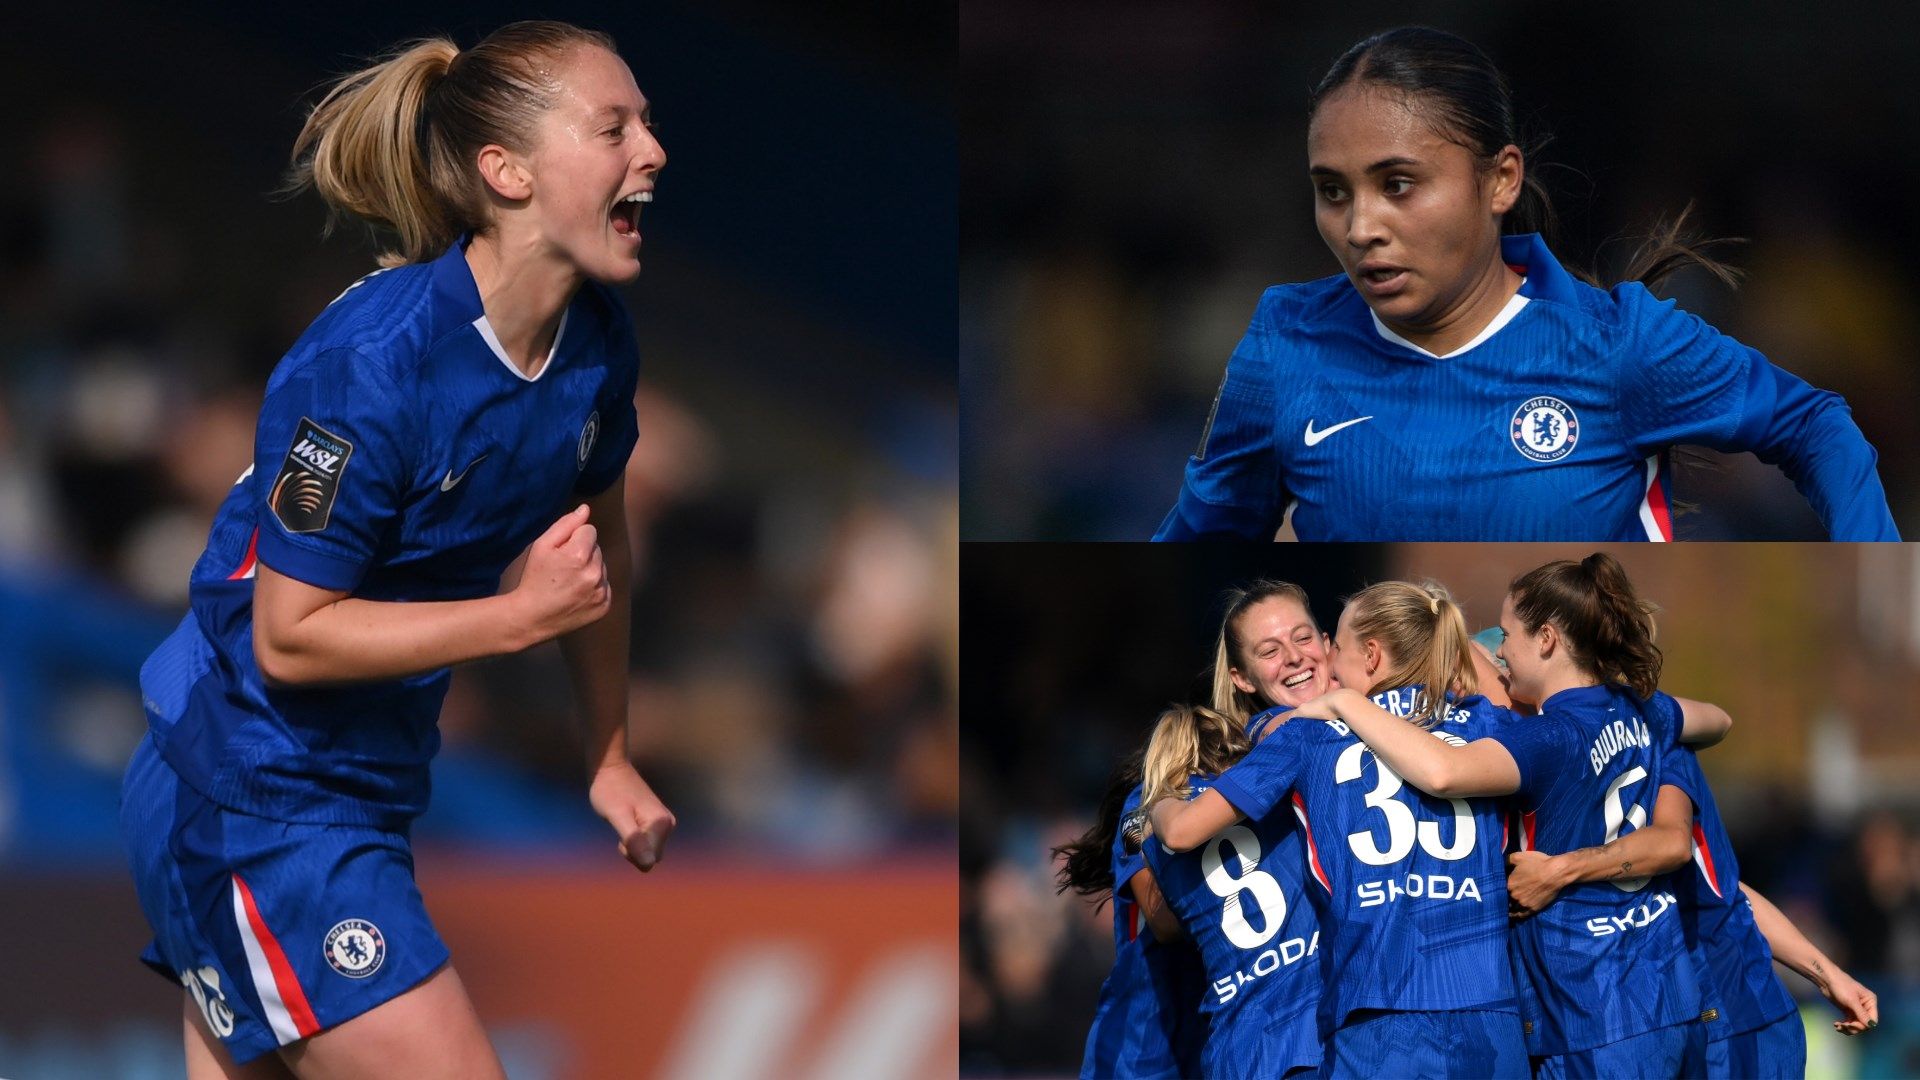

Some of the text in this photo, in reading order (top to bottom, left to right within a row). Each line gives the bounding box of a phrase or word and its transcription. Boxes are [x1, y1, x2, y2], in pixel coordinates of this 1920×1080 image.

[1524, 400, 1567, 415] CHELSEA
[312, 434, 344, 455] BARCLAYS
[1521, 445, 1566, 459] FOOTBALL CLUB
[293, 439, 340, 474] WSL
[1604, 766, 1651, 892] 6
[1201, 825, 1287, 949] 8
[327, 922, 362, 945] CHELSEA
